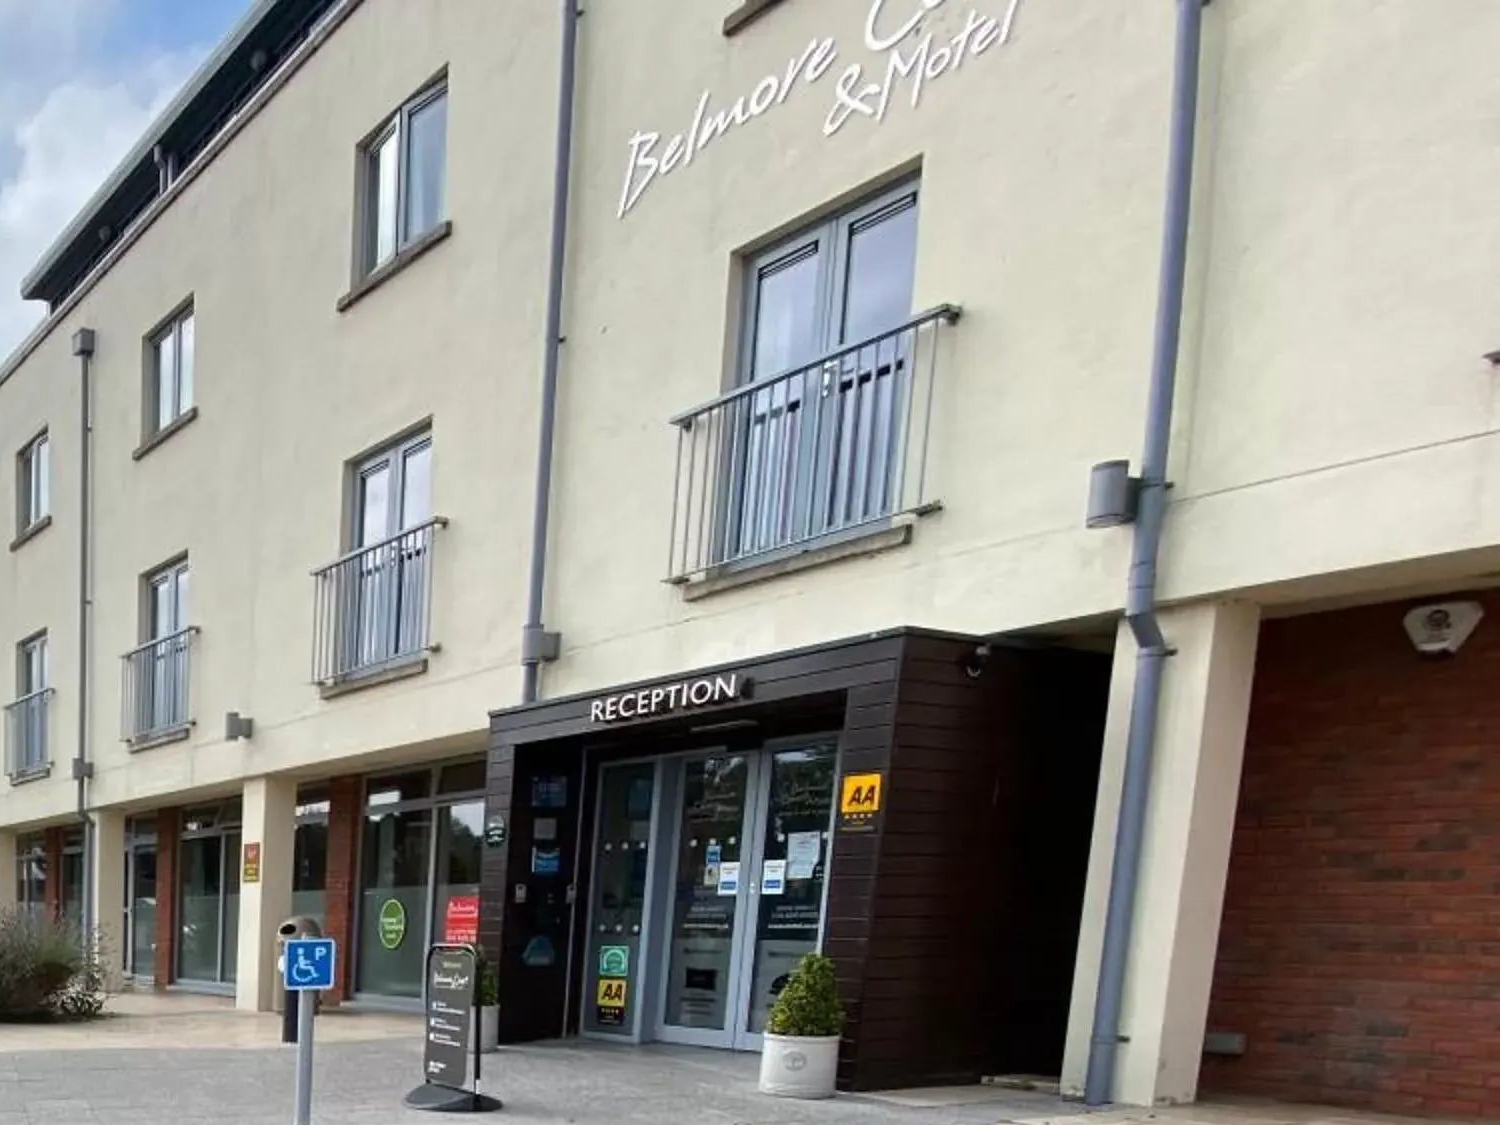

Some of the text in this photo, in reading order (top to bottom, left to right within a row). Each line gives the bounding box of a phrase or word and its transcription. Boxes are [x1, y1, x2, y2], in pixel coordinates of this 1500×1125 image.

[615, 34, 838, 220] Belmore
[590, 673, 737, 722] RECEPTION
[847, 784, 877, 807] AA
[314, 946, 328, 961] P
[602, 982, 623, 1001] AA
